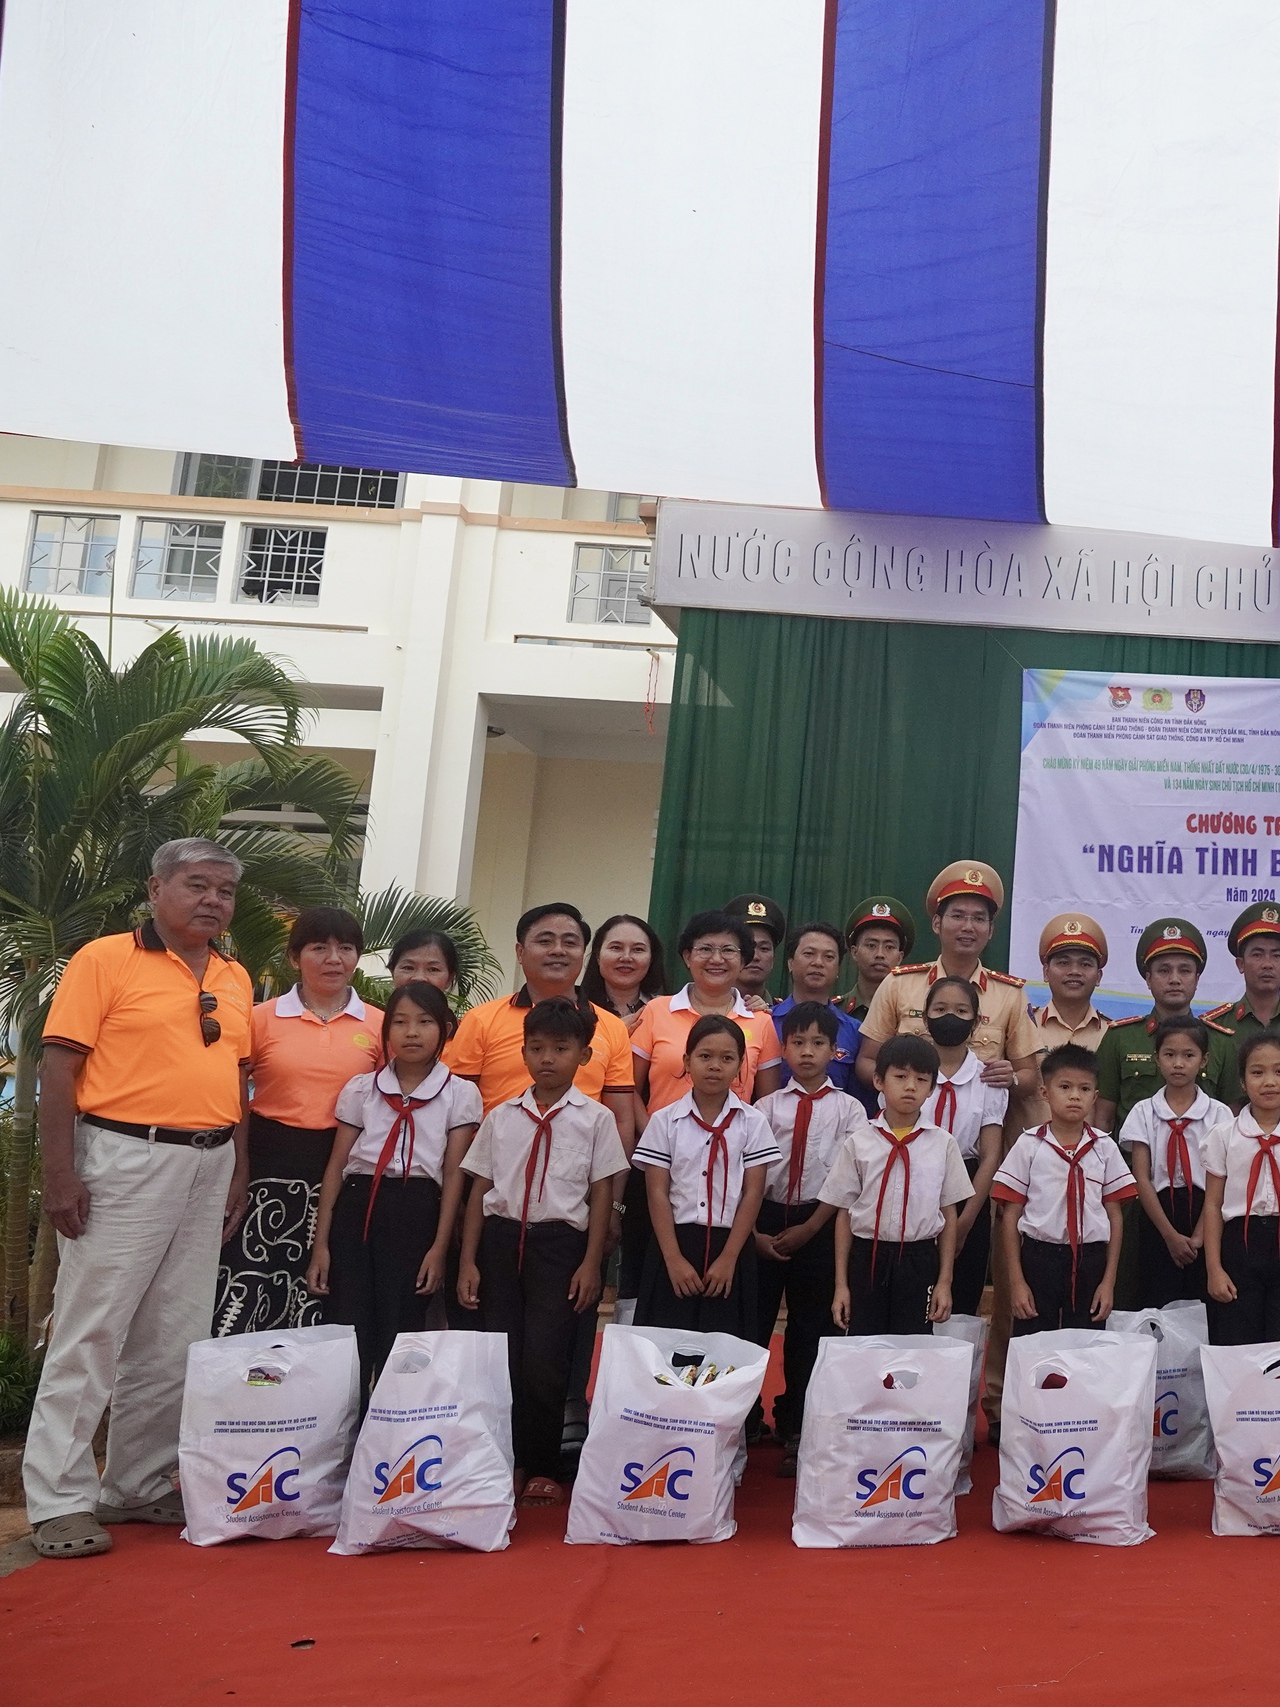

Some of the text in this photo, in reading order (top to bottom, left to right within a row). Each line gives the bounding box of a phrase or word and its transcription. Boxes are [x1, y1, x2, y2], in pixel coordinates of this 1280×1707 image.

[678, 528, 797, 586] NƯỚC
[812, 534, 929, 598] CỘNG
[945, 540, 1027, 598] HÒA
[1042, 548, 1096, 602] XÃ
[1111, 552, 1181, 616] HỘI
[1196, 553, 1276, 614] CHỦ
[1063, 722, 1075, 730] NIÊN
[1076, 723, 1092, 731] PHÒNG
[1106, 722, 1116, 731] SÁT
[1116, 724, 1128, 732] GIAO
[1128, 724, 1144, 732] THÔNG
[1178, 726, 1190, 734] NIÊN
[1190, 726, 1203, 734] CÔNG
[1150, 717, 1163, 725] CÔNG
[1104, 732, 1115, 740] NIÊN
[1116, 732, 1132, 740] PHÒNG
[1146, 732, 1155, 740] SÁT
[1186, 735, 1199, 743] CÔNG
[1043, 756, 1056, 769] CHÀO
[1164, 776, 1172, 790] VÀ
[1172, 780, 1181, 790] 134
[1182, 777, 1194, 790] NĂM
[1195, 778, 1208, 791] NGÀY
[1209, 780, 1220, 791] SINH
[1222, 777, 1232, 792] CHỦ
[1232, 780, 1244, 794] TỊCH
[1244, 778, 1252, 792] HỒ
[1252, 779, 1261, 792] CHÍ
[1262, 781, 1275, 793] MINH
[1186, 813, 1258, 836] CHƯƠNG
[1082, 840, 1183, 875] “NGHĨA
[1195, 841, 1257, 877] TÌNH
[1226, 887, 1276, 902] Năm 2024
[1206, 929, 1230, 938] ngày
[373, 1454, 443, 1505] SAC
[620, 1461, 694, 1502] SAC
[856, 1463, 926, 1509] SAC
[1026, 1464, 1086, 1503] SAC
[227, 1465, 300, 1514] SAC
[1256, 1495, 1276, 1504] Student
[226, 1509, 301, 1523] Student Assistance Center
[372, 1501, 443, 1515] Student Assistance Center
[617, 1500, 687, 1518] Student Assistance Center
[854, 1510, 923, 1519] Student Assistance Center
